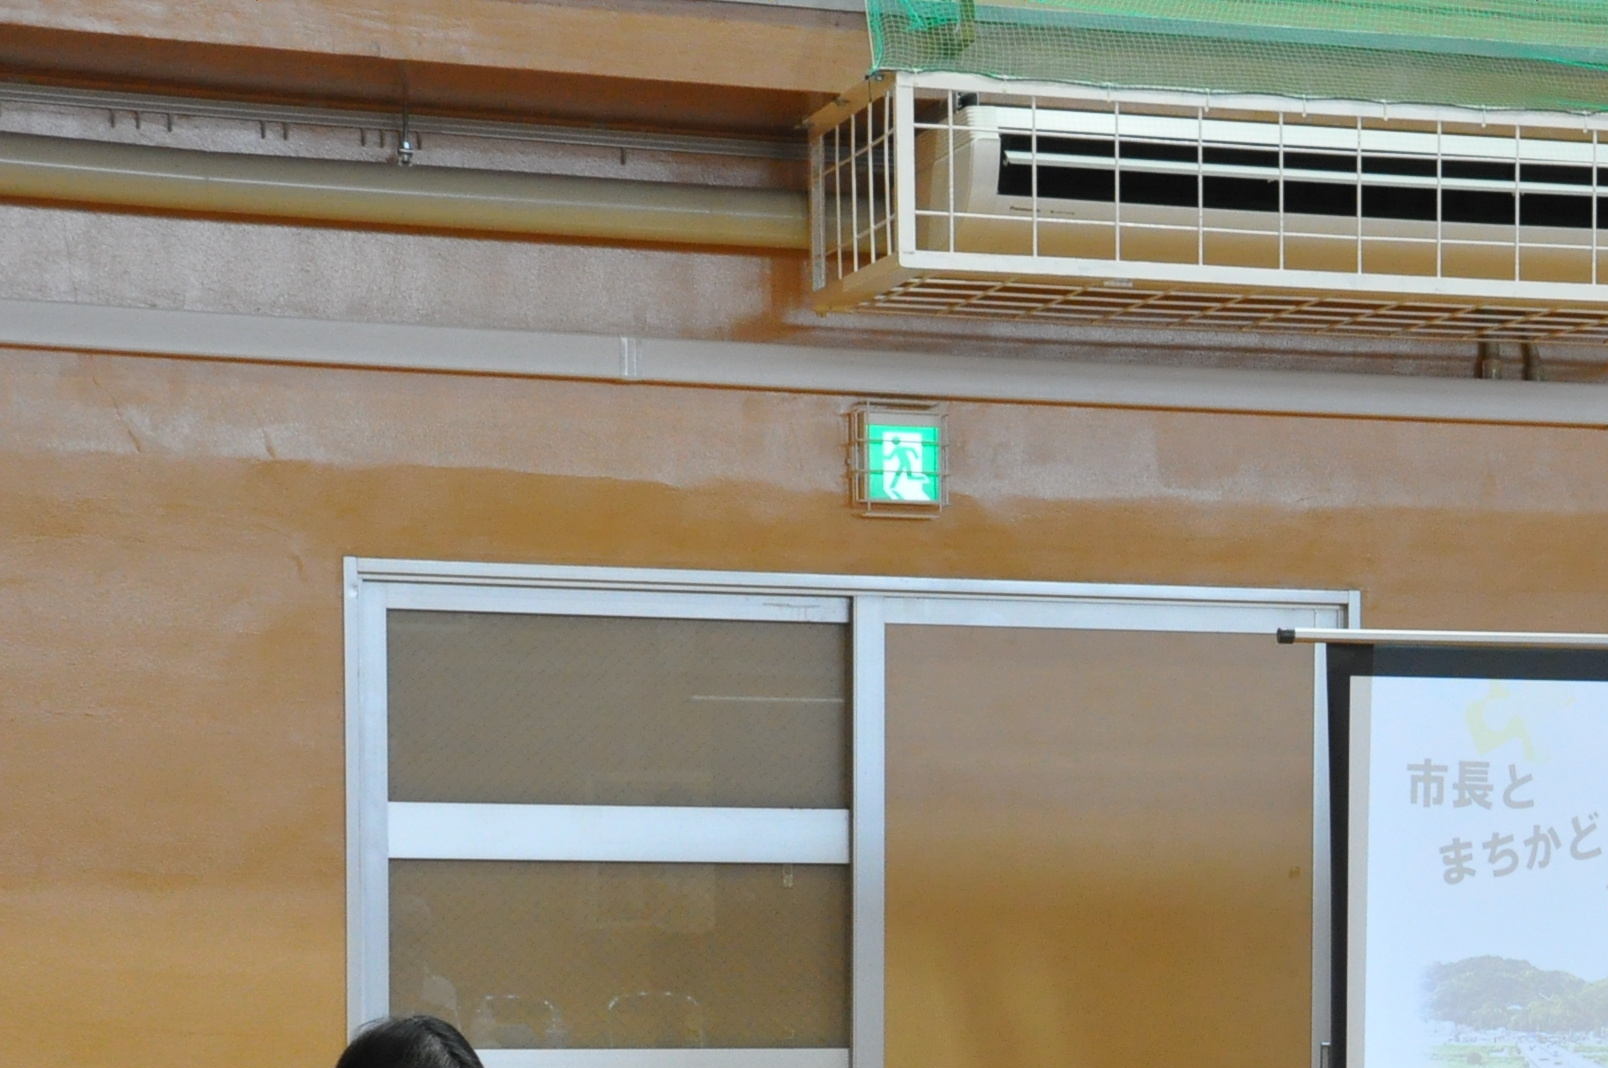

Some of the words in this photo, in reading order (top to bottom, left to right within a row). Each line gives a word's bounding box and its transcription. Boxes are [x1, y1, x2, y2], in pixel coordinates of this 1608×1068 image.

[1406, 758, 1535, 809] 市長と
[1439, 811, 1603, 885] まちかど
